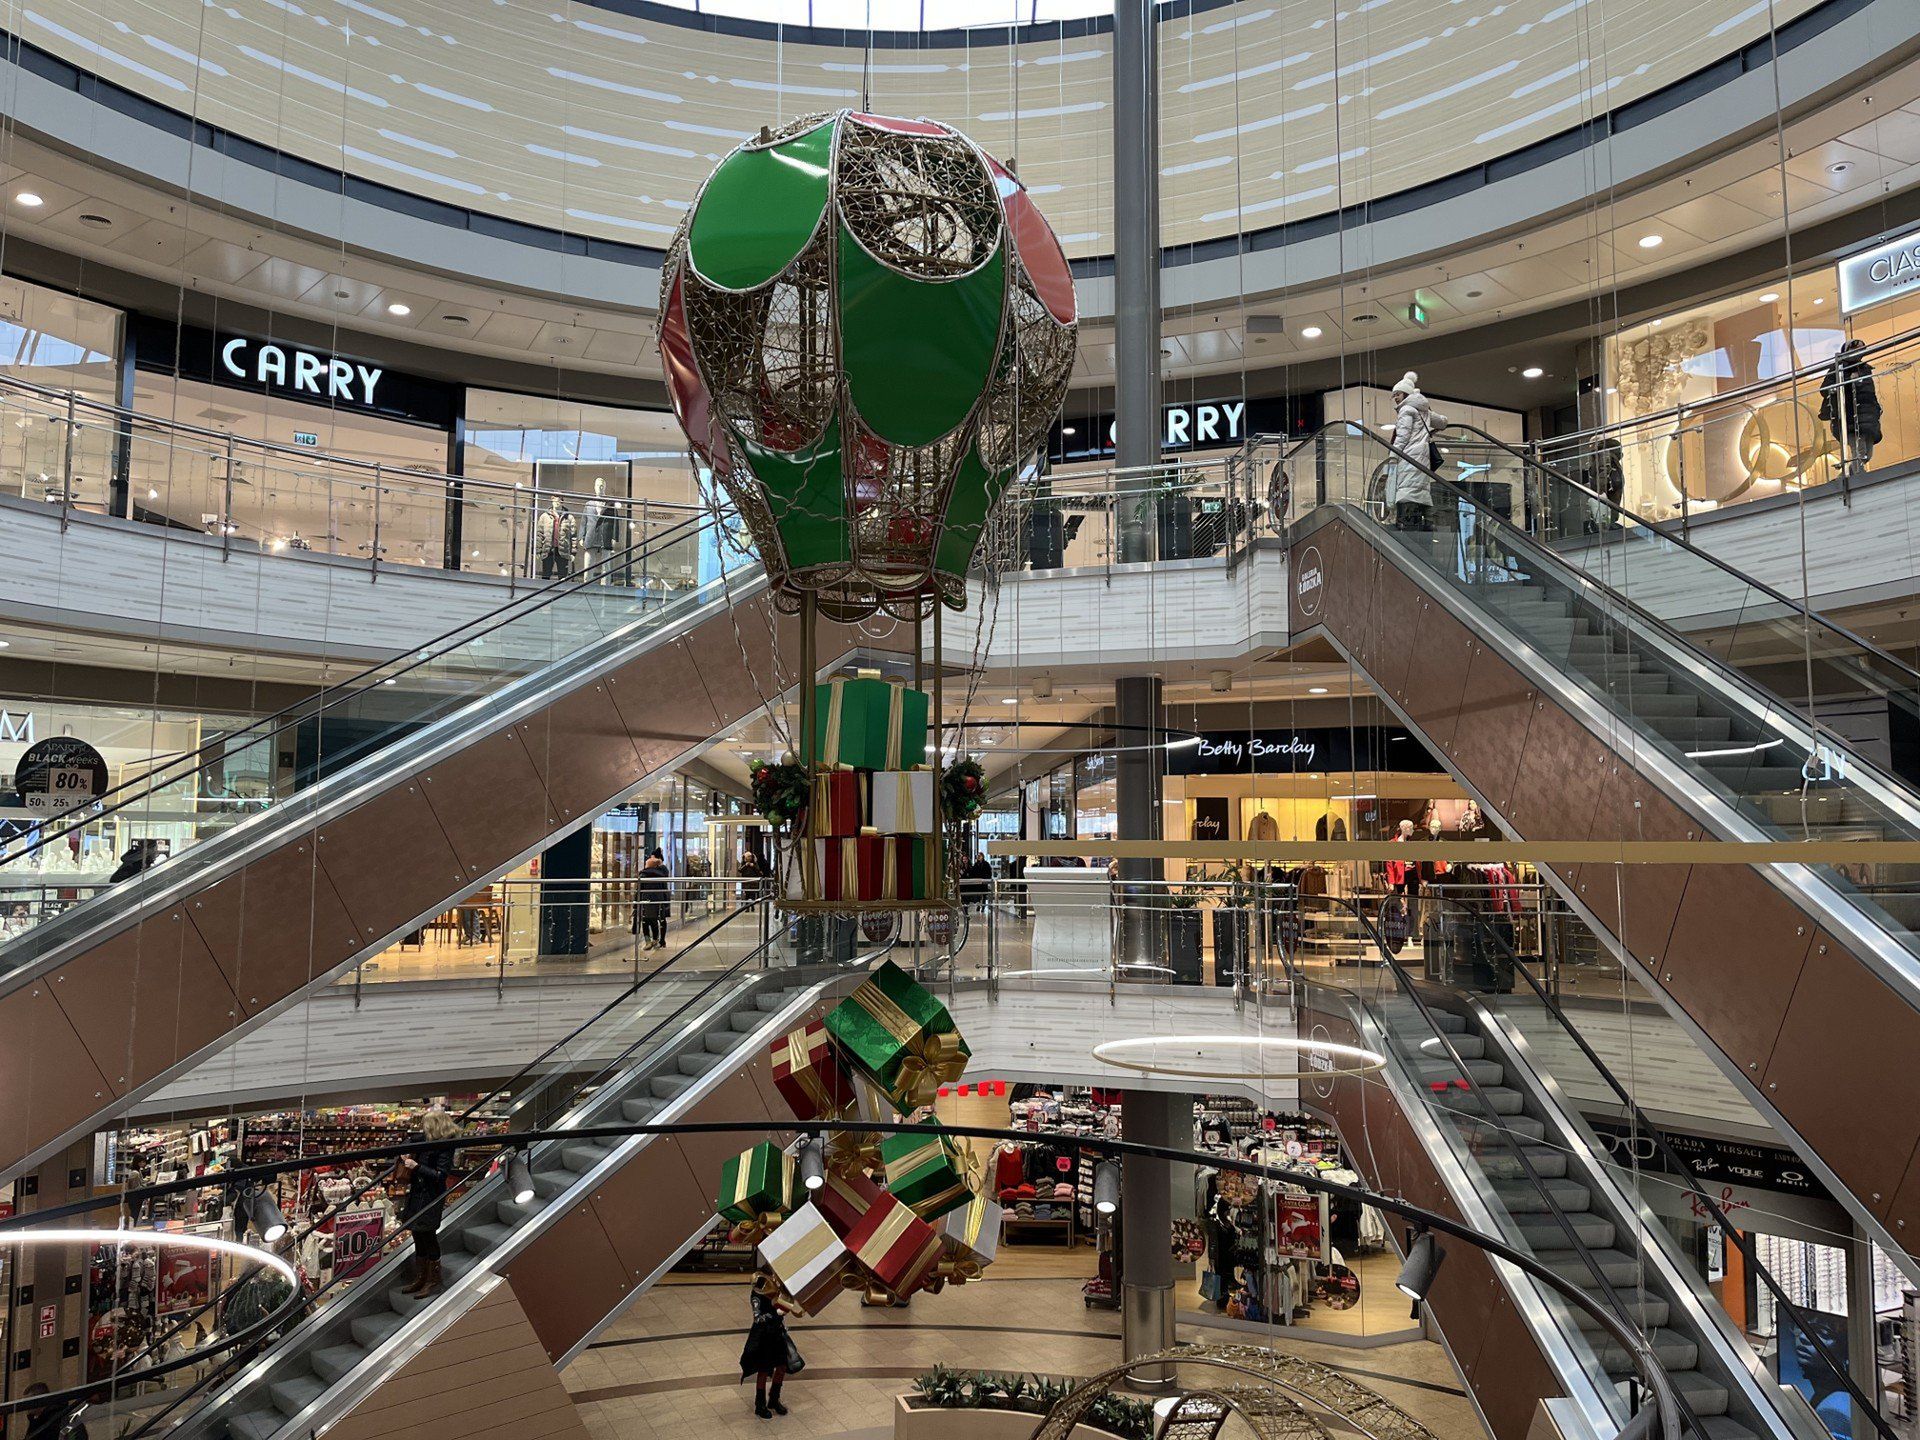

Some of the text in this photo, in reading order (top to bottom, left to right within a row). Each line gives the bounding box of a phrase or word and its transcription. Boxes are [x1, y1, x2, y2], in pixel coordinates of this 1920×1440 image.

[222, 338, 382, 405] CARRY
[28, 753, 66, 763] BLACK
[1197, 736, 1315, 766] Betty Barclay
[55, 772, 87, 790] 80%
[1666, 1136, 1706, 1149] PRADA
